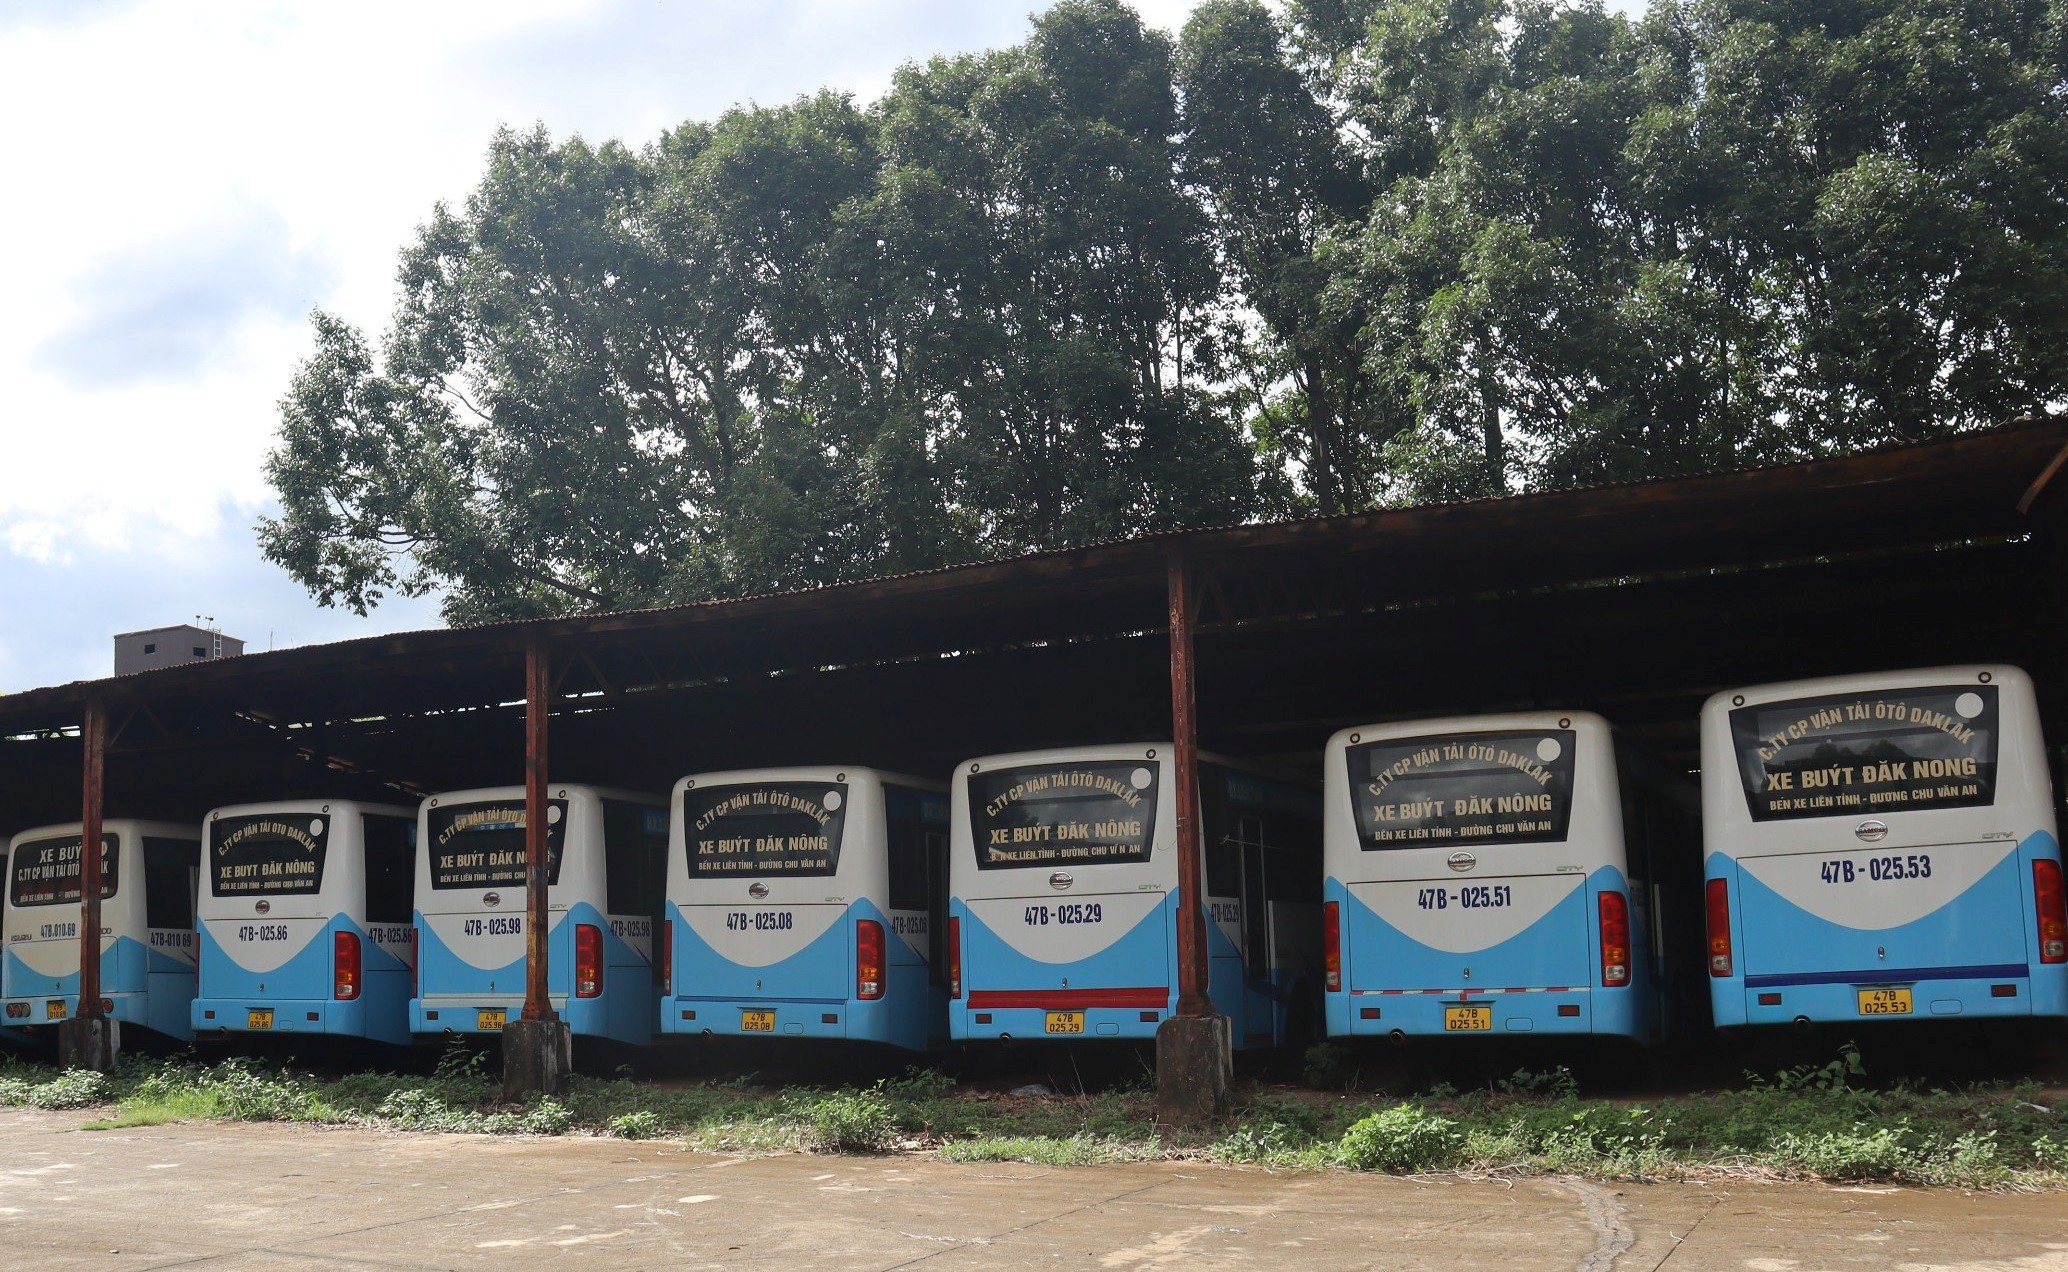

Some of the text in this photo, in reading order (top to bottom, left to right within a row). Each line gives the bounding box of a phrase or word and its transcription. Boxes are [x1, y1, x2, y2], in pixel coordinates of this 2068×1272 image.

[1758, 730, 1789, 761] C.TY
[1787, 720, 1808, 740] CP
[1810, 708, 1844, 730] VẬN
[1846, 700, 1870, 721] TẢI
[1875, 700, 1906, 721] ÔTÔ
[1368, 769, 1394, 797] C.TY
[1394, 758, 1411, 776] CP
[1413, 745, 1440, 768] VẬN
[1767, 772, 1794, 791] XE
[1801, 763, 1855, 789] BUÝT
[1862, 760, 1907, 784] ĐĂK
[986, 793, 1008, 817] C.TY
[1009, 784, 1024, 801] CP
[1071, 770, 1093, 787] ÔTÔ
[1794, 798, 1809, 809] XE
[1912, 789, 1934, 801] CHU
[1937, 786, 1959, 798] VĂN
[1962, 784, 1978, 796] AN
[695, 809, 716, 831] C.TY
[716, 801, 730, 816] CP
[770, 790, 790, 807] ÔTÔ
[1374, 804, 1395, 822] XE
[1400, 797, 1444, 820] BUÝT
[1497, 793, 1552, 813] NÔNG
[438, 824, 455, 845] C.TY
[990, 829, 1009, 845] XE
[1013, 822, 1051, 843] BUÝT
[1095, 819, 1141, 838] NÔNG
[1394, 828, 1407, 840] XE
[1496, 823, 1515, 834] CHU
[1517, 820, 1536, 832] VĂN
[1538, 820, 1551, 831] AN
[39, 849, 54, 863] XE
[60, 842, 82, 861] BUÝ
[218, 837, 233, 856] C.TY
[232, 829, 243, 843] CP
[698, 840, 714, 854] XE
[718, 835, 750, 853] BUÝT
[789, 834, 828, 851] NÔNG
[1008, 851, 1017, 859] XE
[1091, 846, 1107, 855] CHU
[1129, 844, 1141, 853] AN
[220, 866, 232, 879] XE
[285, 858, 315, 874] NÔNG
[440, 855, 454, 869] XE
[456, 850, 484, 867] BUÝT
[712, 861, 721, 870] XE
[784, 860, 798, 869] CHU
[816, 859, 827, 868] AN
[32, 867, 41, 880] CP
[452, 874, 460, 882] XE
[230, 882, 237, 890] XE
[1025, 903, 1102, 925] 47B-025.29
[1874, 991, 1896, 1002] 47B
[752, 1013, 765, 1021] 47B
[1057, 1013, 1073, 1022] 47B
[1459, 1009, 1478, 1019] 47B
[1865, 1002, 1907, 1013] 025.53
[1050, 1023, 1080, 1032] 025.29
[1450, 1020, 1485, 1029] 025.51
